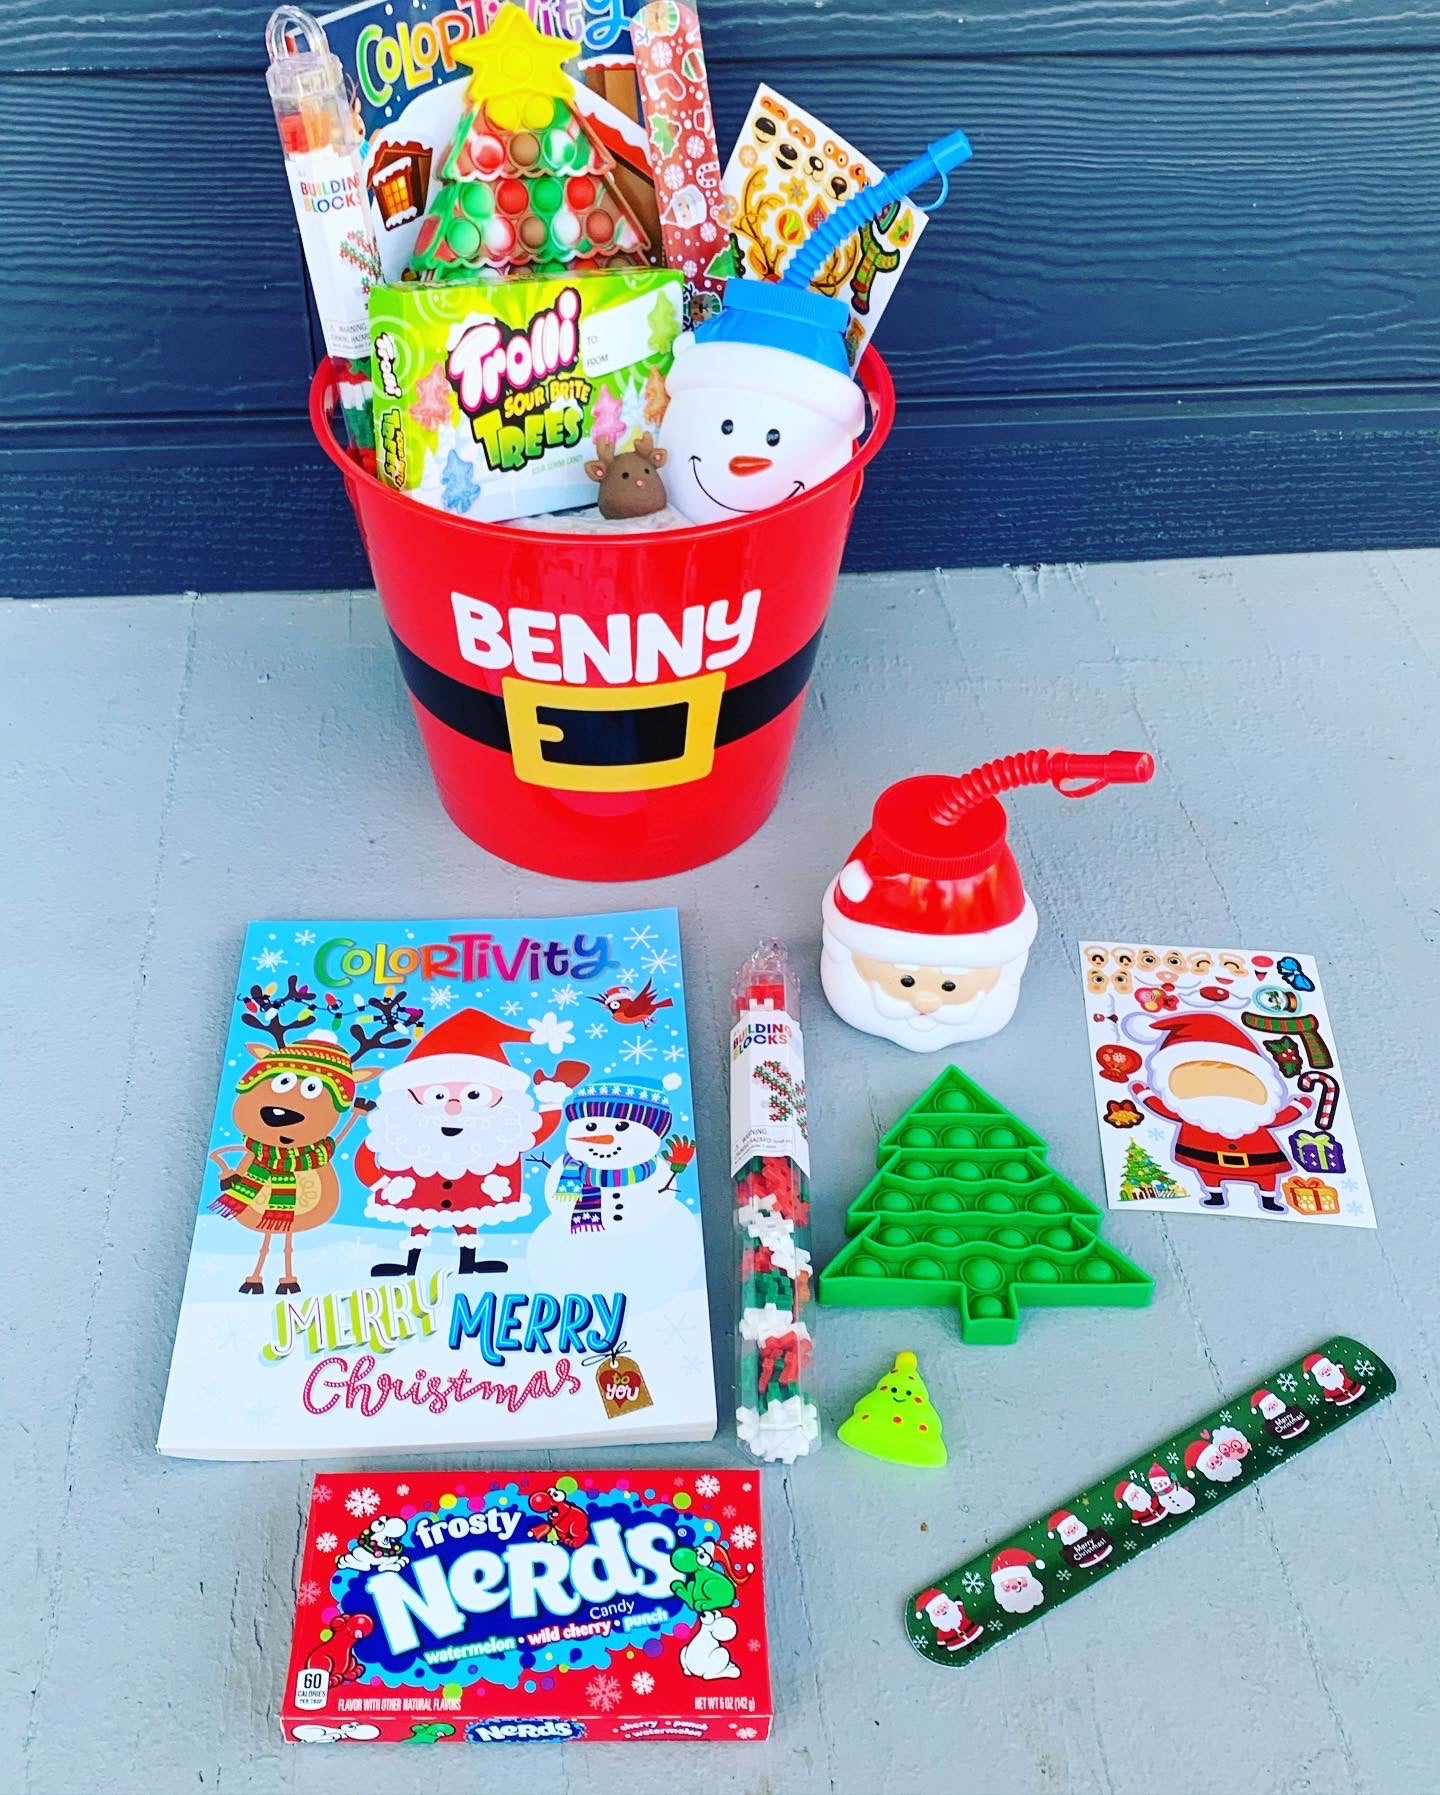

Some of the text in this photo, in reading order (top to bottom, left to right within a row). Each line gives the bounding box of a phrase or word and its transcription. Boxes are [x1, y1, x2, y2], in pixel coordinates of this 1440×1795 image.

[447, 288, 579, 412] Trolli
[504, 386, 545, 418] SOUR
[472, 405, 583, 469] TREES
[451, 589, 762, 684] BENNY
[733, 1023, 792, 1050] BUILDING
[733, 1034, 788, 1060] BLOCKS
[262, 1268, 627, 1367] MERRY MERRY
[303, 1355, 581, 1417] Christmas
[612, 1373, 630, 1384] to
[416, 1508, 522, 1548] frosty
[1073, 1537, 1106, 1561] Christmas!
[1074, 1539, 1094, 1553] Merry
[590, 1599, 635, 1620] Candy
[424, 1608, 669, 1664] watermelon wild cherry punch
[303, 1673, 322, 1689] 60
[338, 1698, 362, 1712] FLAVOR
[363, 1698, 380, 1711] WITH
[381, 1698, 402, 1711] OTHER
[403, 1698, 432, 1711] NATURAL
[694, 1696, 707, 1710] NET
[707, 1696, 719, 1710] WT
[725, 1696, 734, 1710] OZ
[620, 1720, 658, 1731] cherry
[632, 1728, 703, 1738] watermelon
